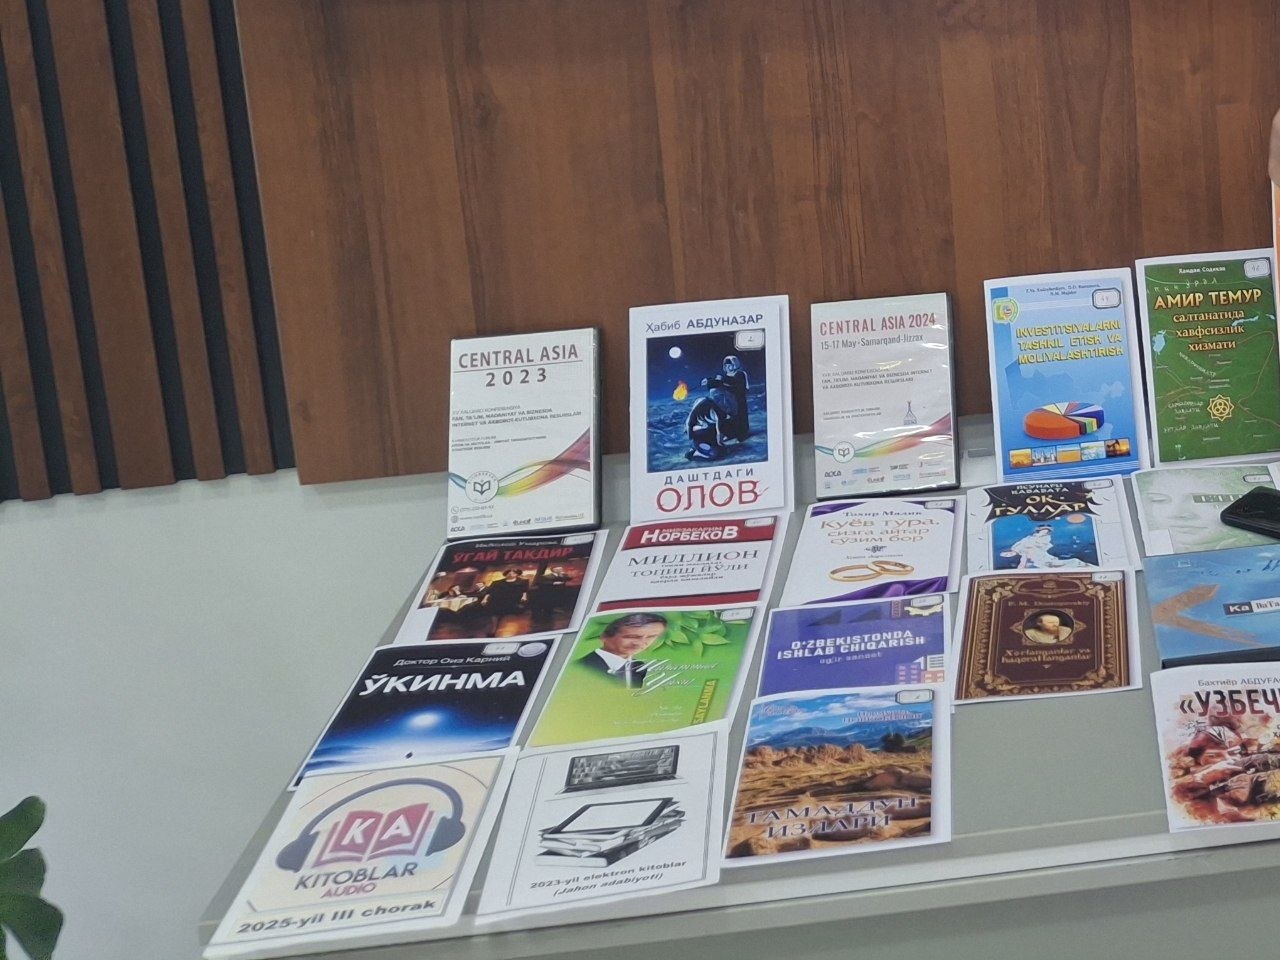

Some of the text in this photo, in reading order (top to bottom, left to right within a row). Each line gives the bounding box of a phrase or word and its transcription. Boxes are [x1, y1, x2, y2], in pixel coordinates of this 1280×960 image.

[1154, 289, 1262, 310] АМИР ТЕМУР
[686, 313, 763, 330] АБДУНАЗАР
[819, 312, 936, 336] CENTRAL ASIA 2024
[1173, 310, 1245, 323] салтанатида
[1176, 325, 1245, 339] хавфсизлик
[1188, 340, 1236, 351] хизмати
[459, 344, 578, 369] CENTRAL ASIA
[486, 368, 547, 387] 2023
[664, 468, 754, 486] ДАШТДАГИ
[656, 480, 769, 513] ОЛОВ
[628, 549, 760, 566] МИЛЛИОН
[777, 636, 926, 660] ISHLAB CHIQARISH
[359, 670, 526, 696] ЎКИНМА
[295, 862, 418, 890] KITOBLAR
[583, 866, 635, 882] elektron
[638, 860, 687, 872] kitoblar
[320, 883, 377, 899] AUDIO
[236, 900, 437, 933] 2025-yil III chorak
